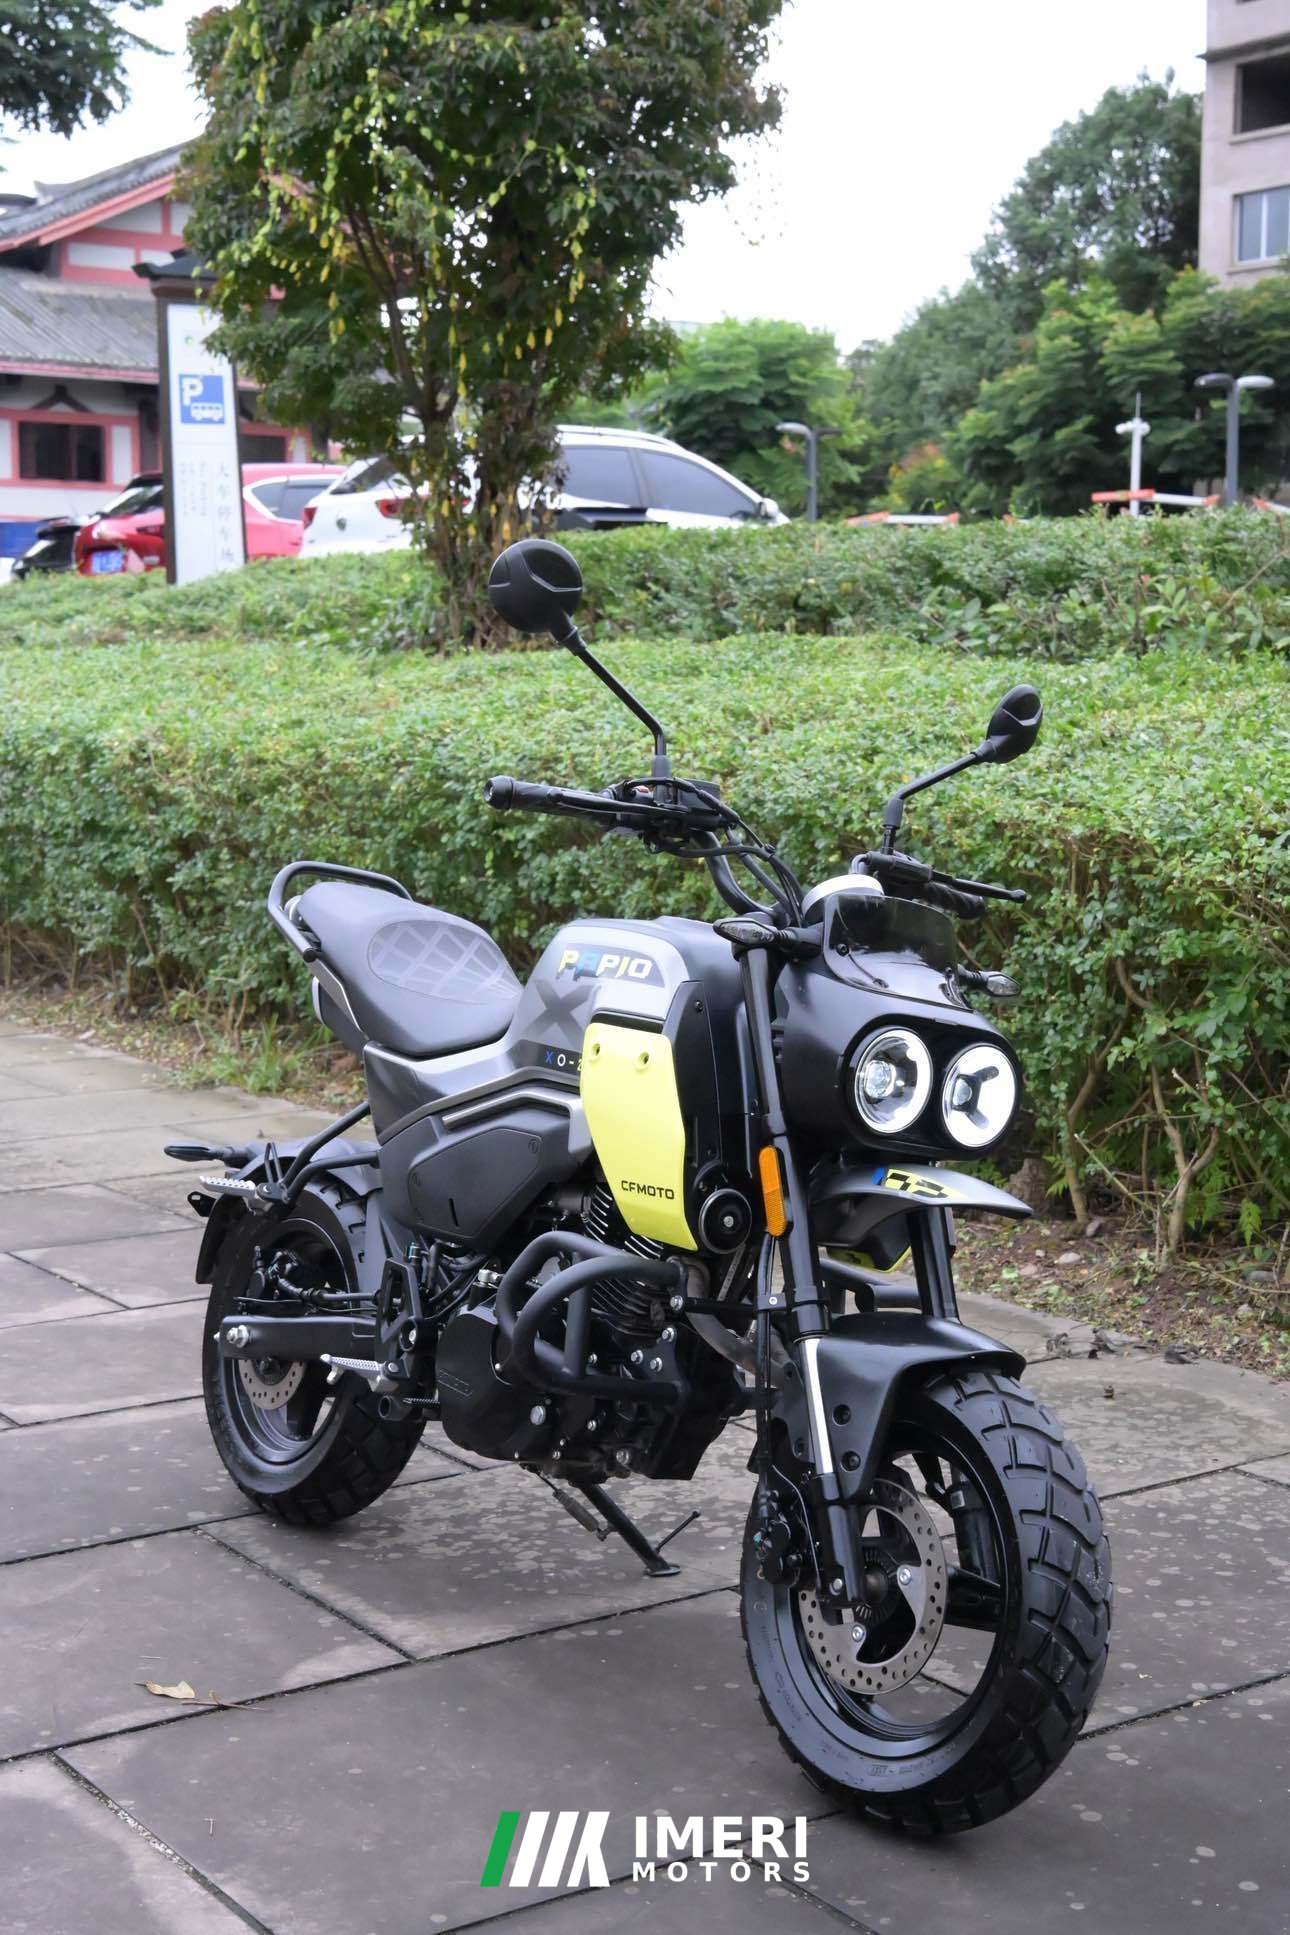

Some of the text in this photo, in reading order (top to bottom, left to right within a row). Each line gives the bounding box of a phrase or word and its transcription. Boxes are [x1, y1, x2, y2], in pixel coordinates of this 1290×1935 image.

[181, 377, 204, 406] P
[557, 949, 653, 981] PAPIO
[621, 1180, 675, 1200] CFMOTO
